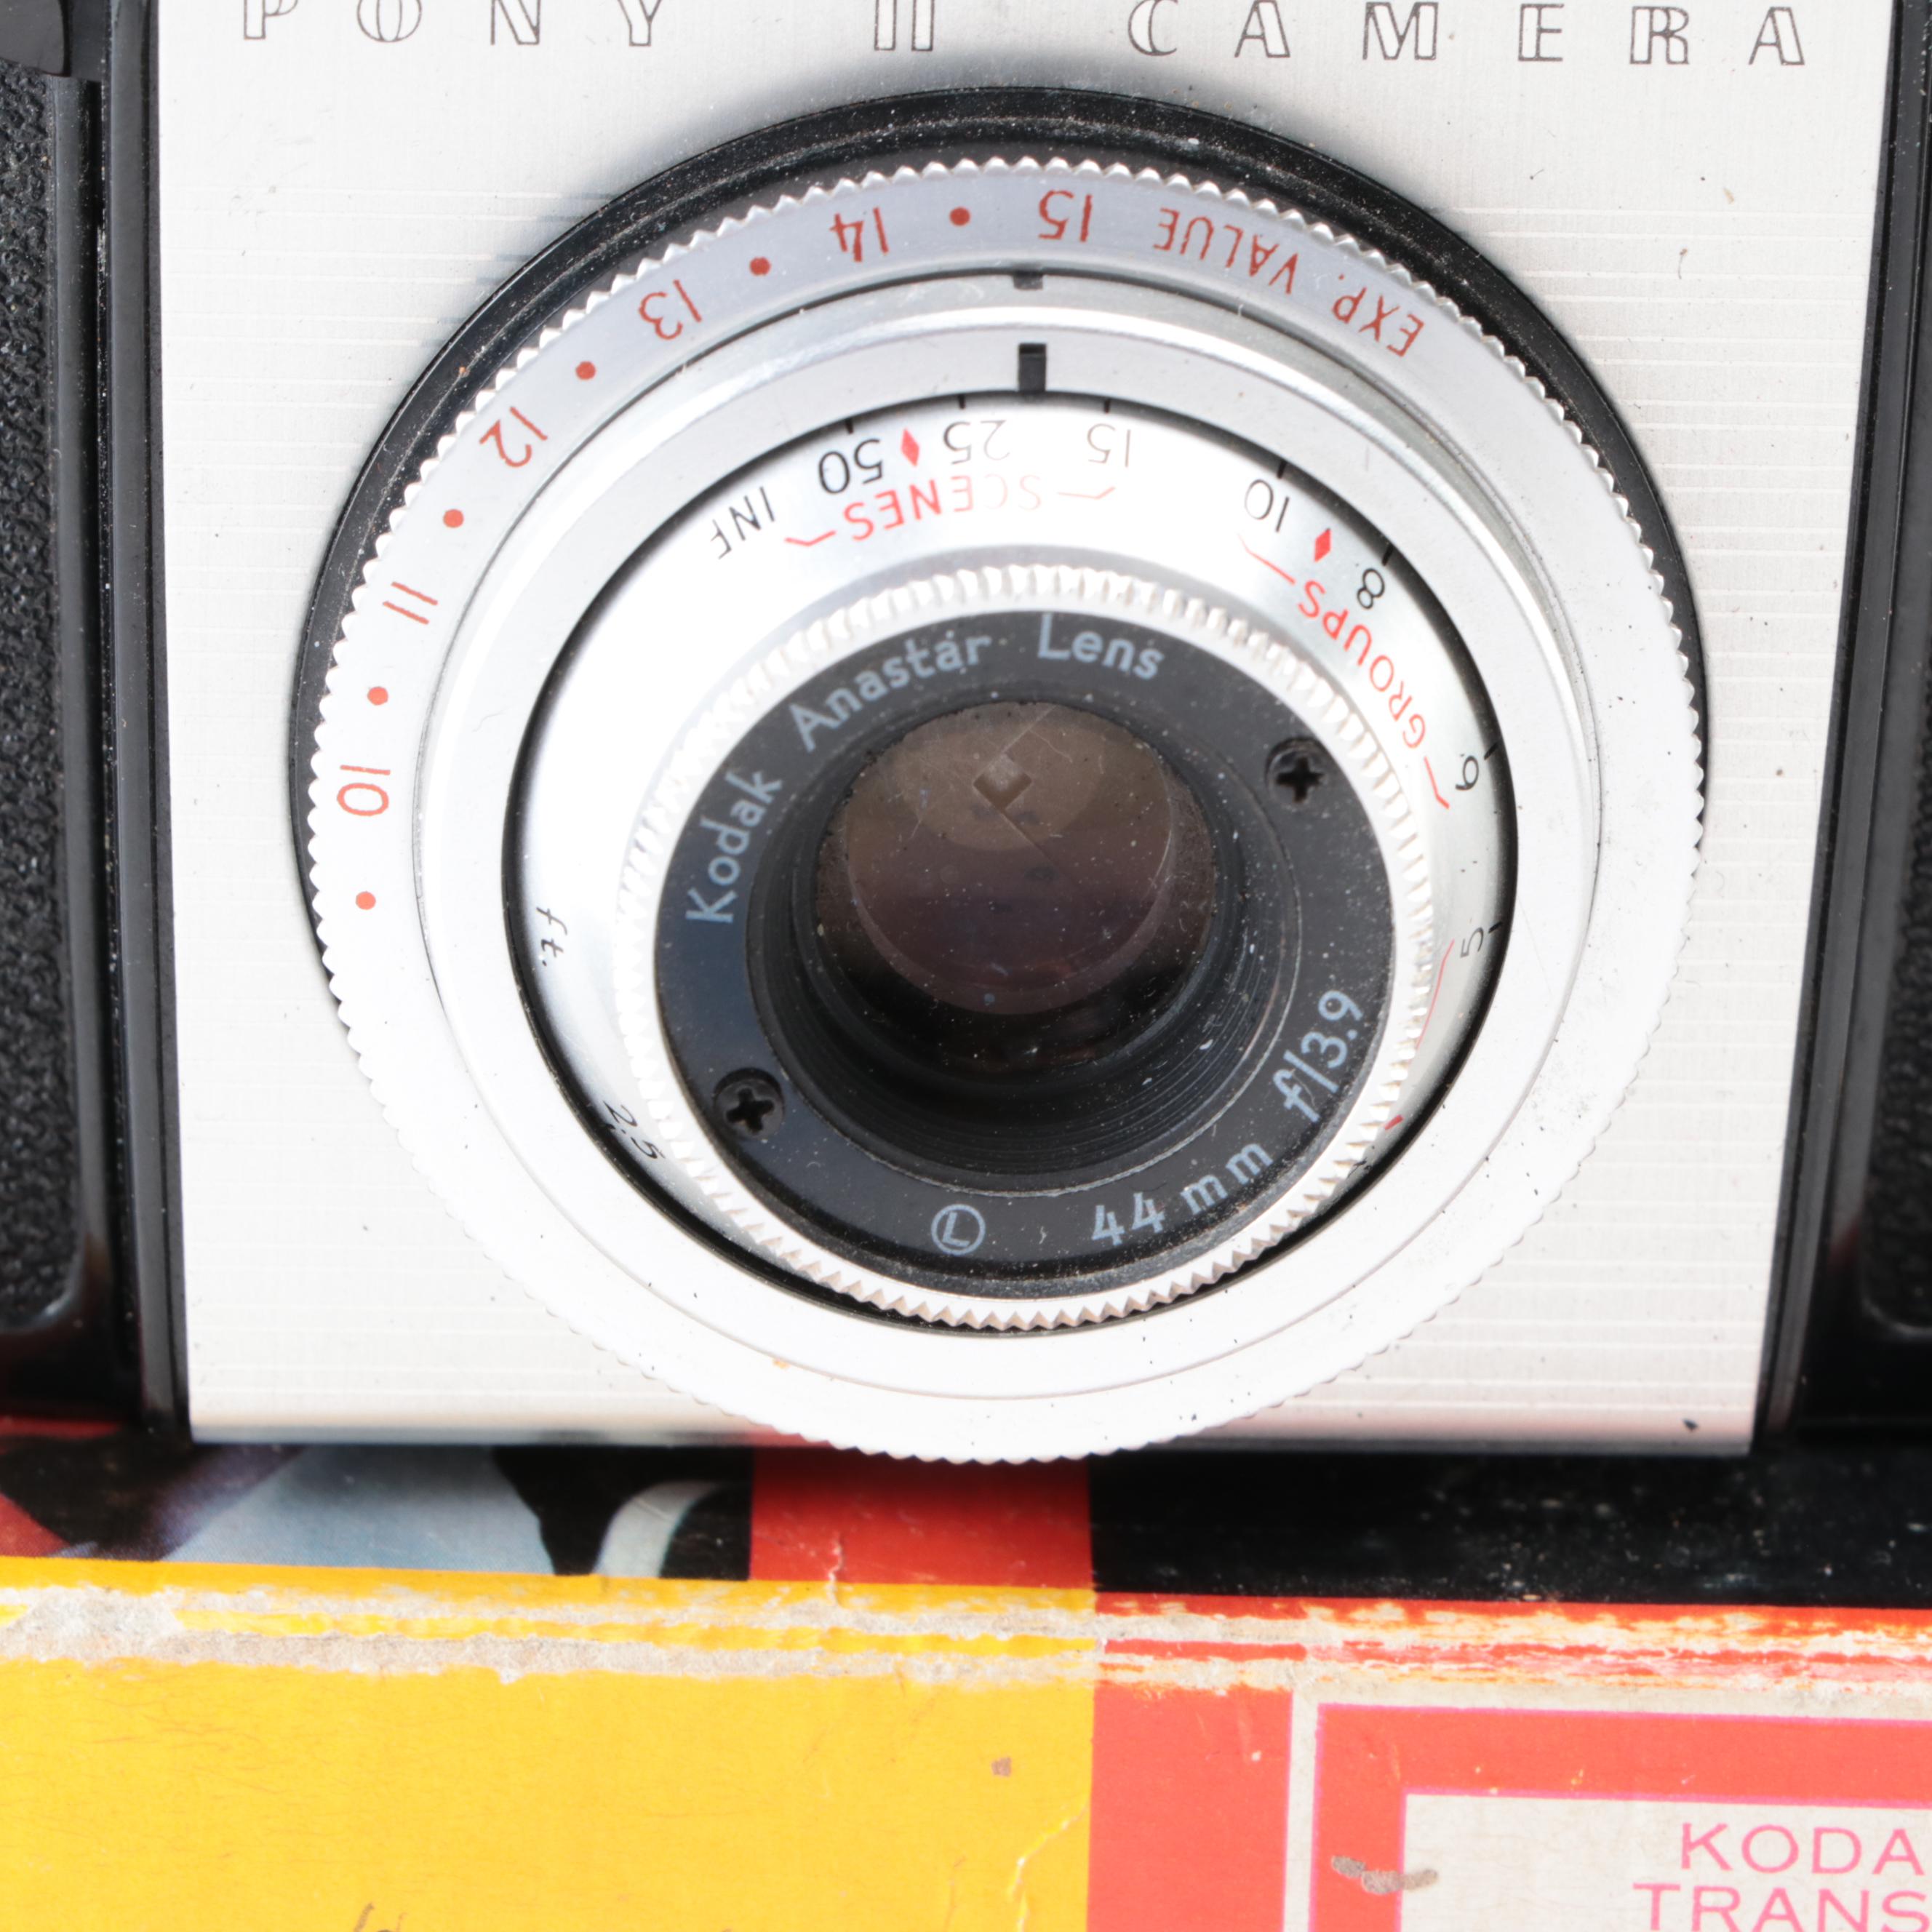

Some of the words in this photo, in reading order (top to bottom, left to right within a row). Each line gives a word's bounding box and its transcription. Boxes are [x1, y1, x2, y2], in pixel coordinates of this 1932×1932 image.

[1128, 0, 1807, 66] CAMERA
[829, 207, 889, 262] 14
[1038, 190, 1093, 243] 15
[1153, 208, 1300, 294] VALUE
[638, 280, 702, 340] 13
[1332, 274, 1424, 357] EXP.
[479, 407, 548, 468] 12
[943, 419, 1010, 466] 25
[1087, 423, 1131, 468] 15
[818, 438, 885, 495] 50
[710, 486, 776, 559] INF
[842, 474, 1042, 540] SCENES
[1244, 479, 1290, 532] 10
[1357, 568, 1385, 609] 8
[1298, 580, 1426, 749] GROUPS
[336, 765, 391, 816] 10
[685, 769, 783, 924] Kodak
[1037, 612, 1162, 681] Lens
[1459, 927, 1485, 959] 5
[1091, 1191, 1167, 1246] 44
